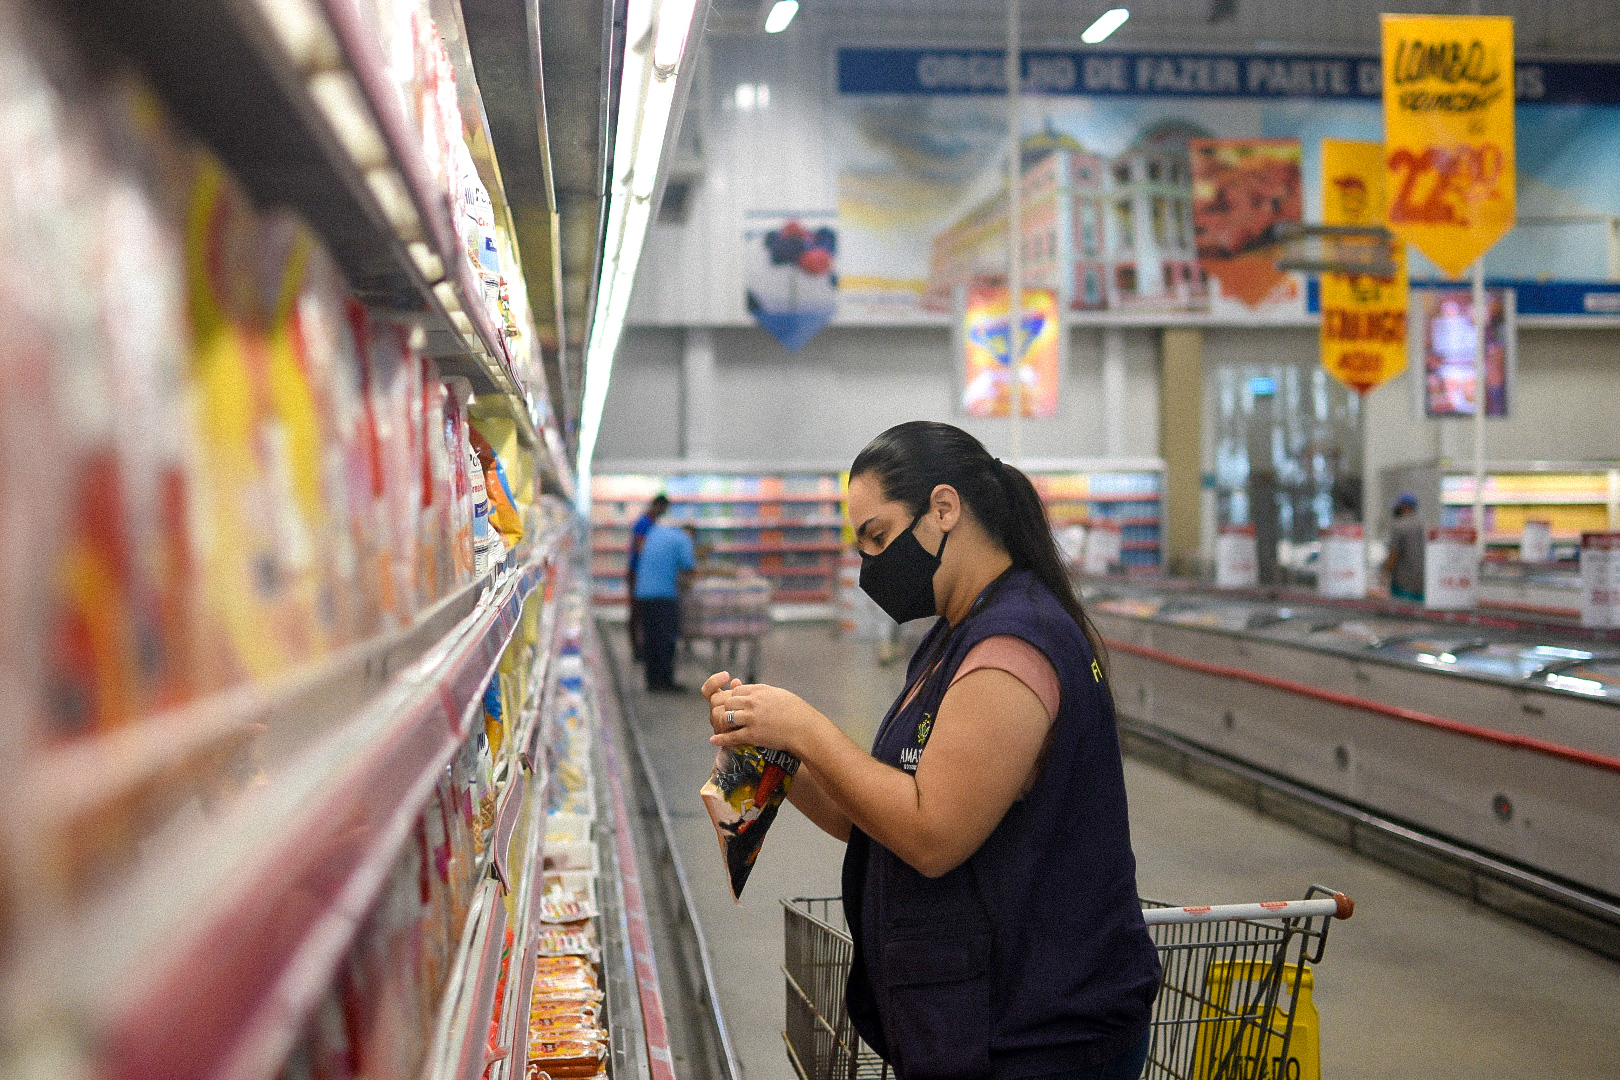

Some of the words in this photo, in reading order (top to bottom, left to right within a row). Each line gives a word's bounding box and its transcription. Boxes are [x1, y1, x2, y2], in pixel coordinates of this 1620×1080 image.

[1083, 56, 1128, 90] DE
[1136, 57, 1239, 91] FAZER
[1247, 59, 1350, 94] PARTE
[1358, 61, 1382, 94] D
